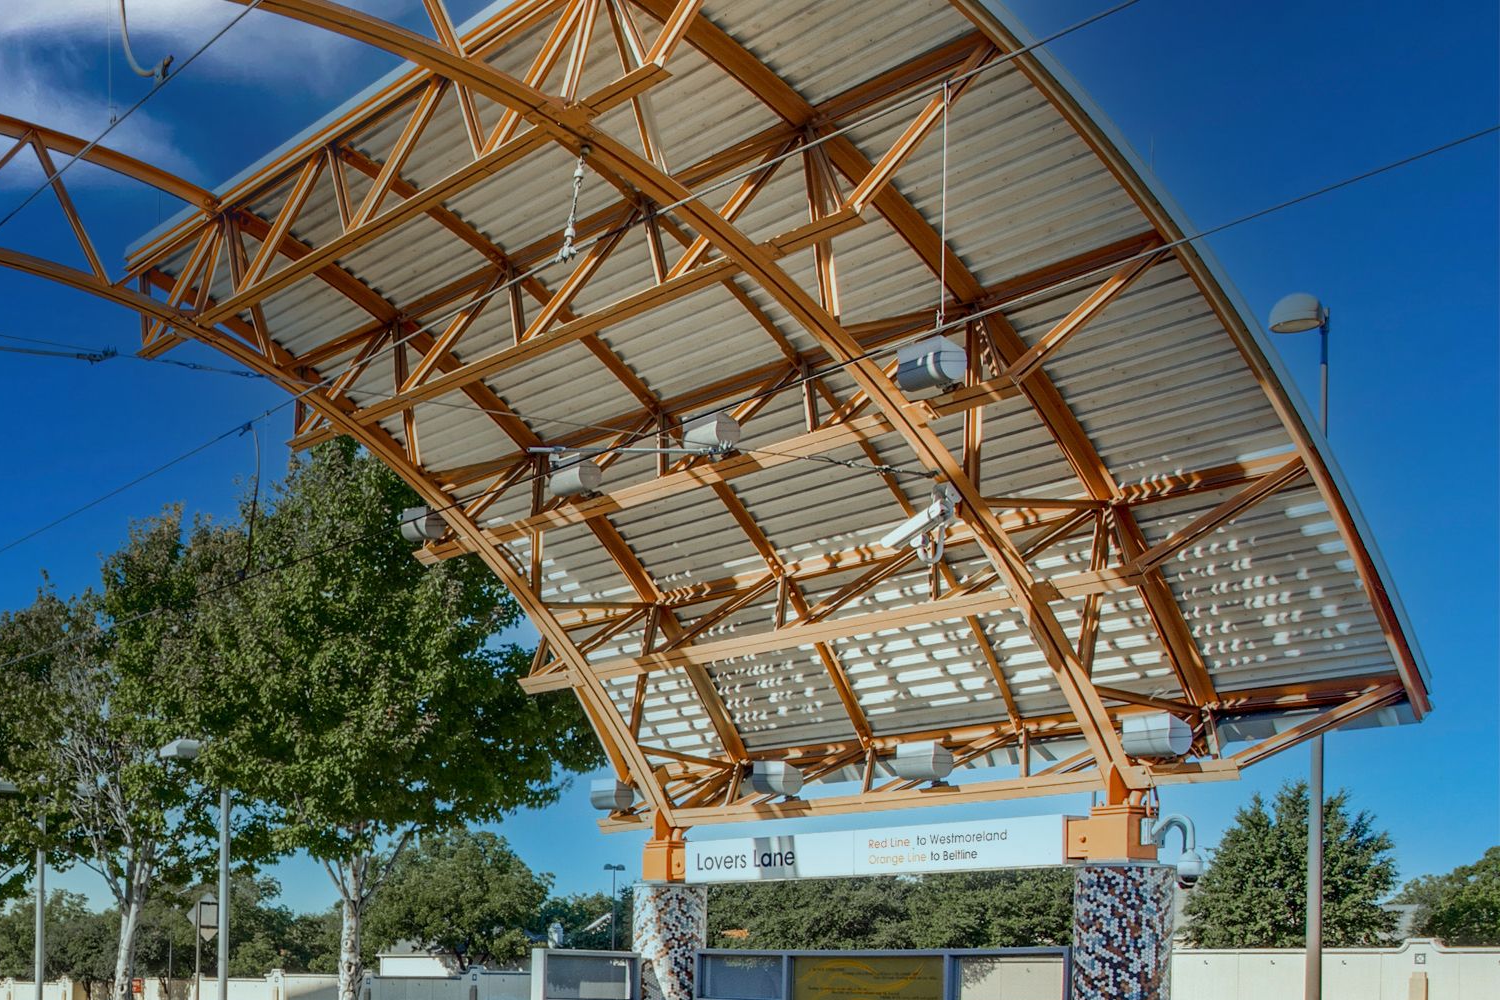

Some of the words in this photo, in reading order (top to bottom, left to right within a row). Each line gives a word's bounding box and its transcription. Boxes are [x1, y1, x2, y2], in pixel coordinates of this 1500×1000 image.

[868, 839, 887, 849] Red
[891, 838, 910, 848] Line
[916, 835, 926, 846] to
[930, 829, 1008, 845] Westmoreland
[697, 853, 747, 871] Lovers
[753, 850, 795, 868] Lane
[868, 854, 905, 866] Orange
[908, 852, 927, 863] Line
[930, 851, 940, 861] to
[943, 849, 978, 861] Beltline
